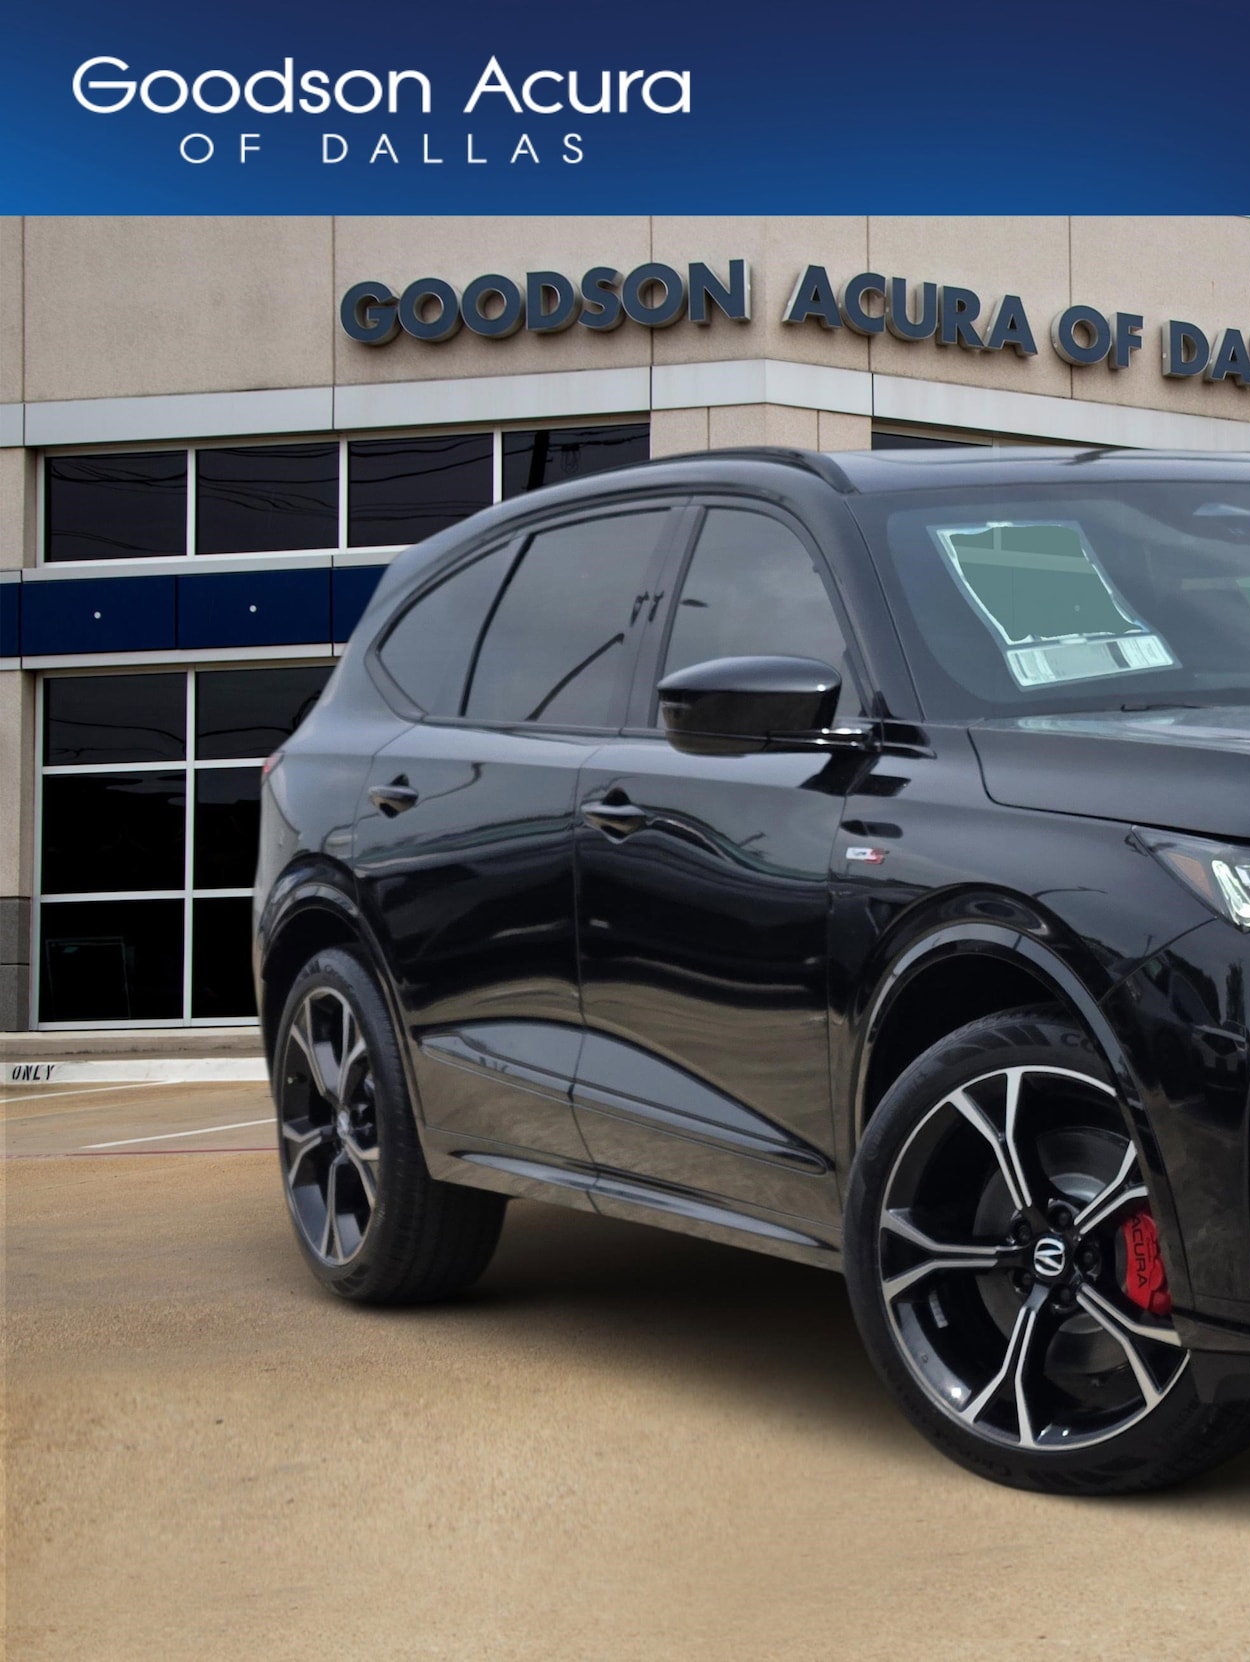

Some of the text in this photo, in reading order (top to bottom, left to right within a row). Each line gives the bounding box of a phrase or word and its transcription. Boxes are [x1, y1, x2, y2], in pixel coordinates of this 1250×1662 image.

[340, 259, 751, 345] GOODSON
[782, 264, 1038, 356] ACURA
[1052, 304, 1143, 369] OF
[12, 1064, 55, 1080] ONLY
[1131, 1217, 1148, 1288] ACURA
